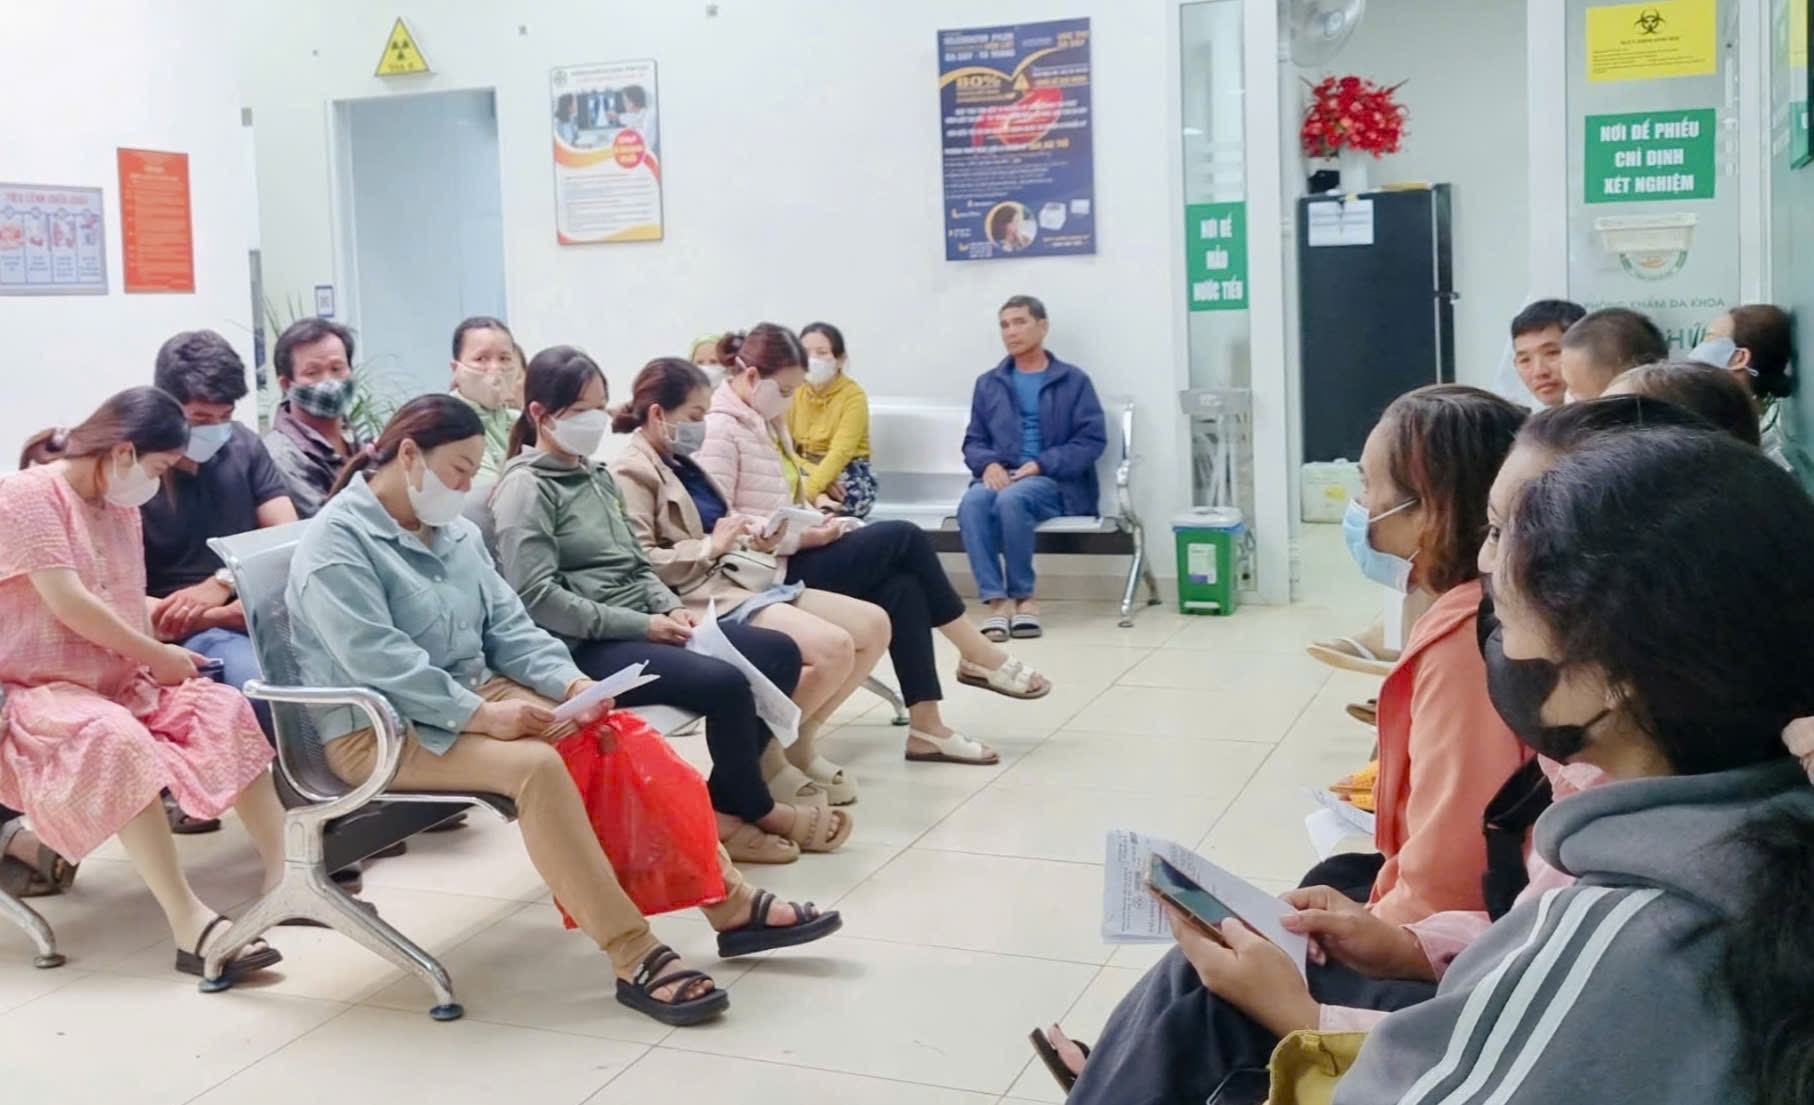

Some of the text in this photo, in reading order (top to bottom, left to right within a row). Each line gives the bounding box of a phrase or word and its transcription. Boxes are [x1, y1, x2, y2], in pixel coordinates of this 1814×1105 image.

[1646, 148, 1684, 169] ĐỊNH
[1604, 172, 1695, 195] XÉT NGHIỆM
